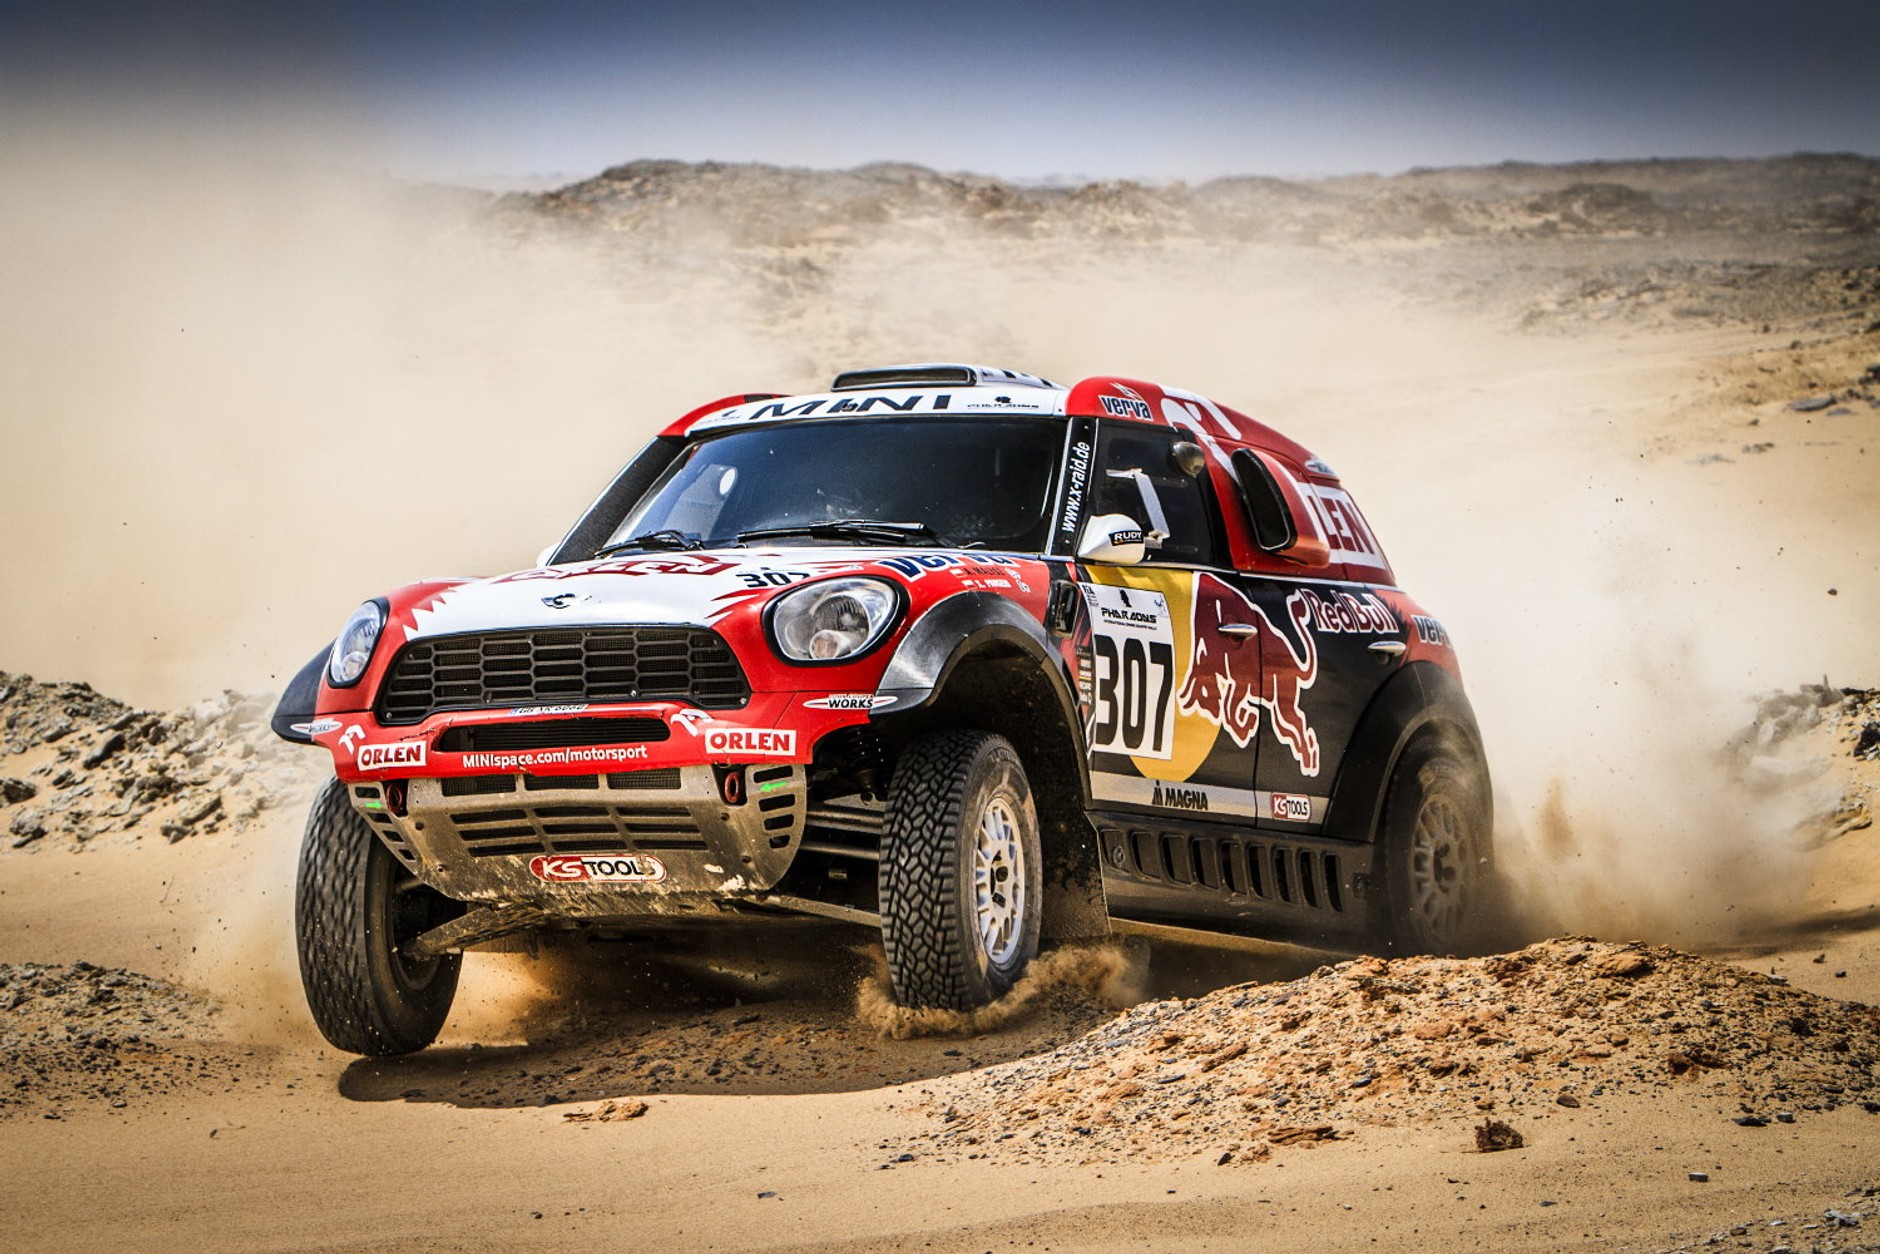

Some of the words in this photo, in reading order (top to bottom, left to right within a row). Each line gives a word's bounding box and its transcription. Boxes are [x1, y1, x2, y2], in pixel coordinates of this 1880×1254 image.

[749, 395, 951, 420] MINI
[1100, 395, 1152, 420] verva
[1114, 531, 1142, 541] RUDY
[1300, 588, 1356, 632] Red
[1340, 593, 1399, 633] Bull
[828, 698, 874, 708] WORKS
[1093, 634, 1173, 752] 307
[710, 732, 790, 752] ORLEN
[361, 744, 421, 765] ORLEN
[462, 745, 648, 769] MINIspace.com/motorsport
[1165, 787, 1208, 811] MAGNA
